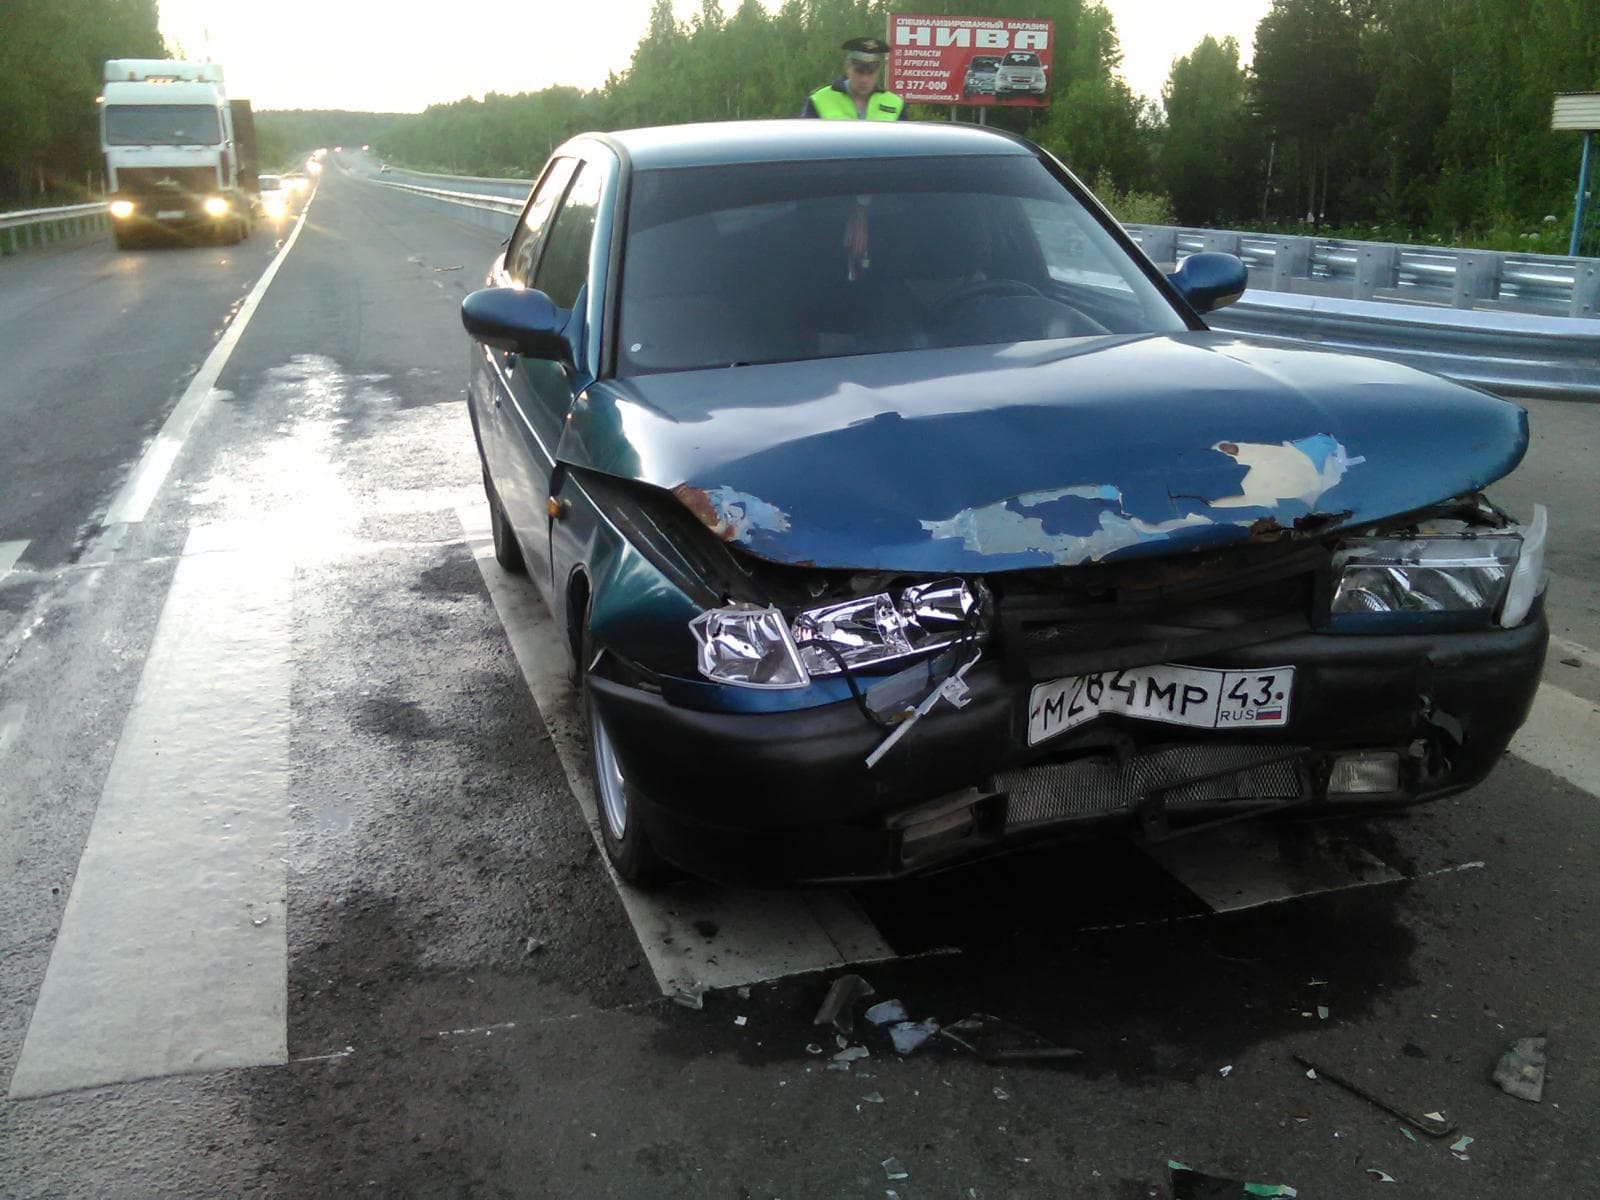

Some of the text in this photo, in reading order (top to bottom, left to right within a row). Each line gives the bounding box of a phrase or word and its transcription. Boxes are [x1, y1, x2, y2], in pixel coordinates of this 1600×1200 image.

[1008, 22, 1049, 31] МАГАЗИН
[896, 27, 1048, 49] НИВА
[902, 69, 950, 78] АКСЕССУАРЫ
[906, 81, 947, 90] 377-000
[1228, 675, 1276, 708] 43
[1219, 708, 1255, 722] RUS
